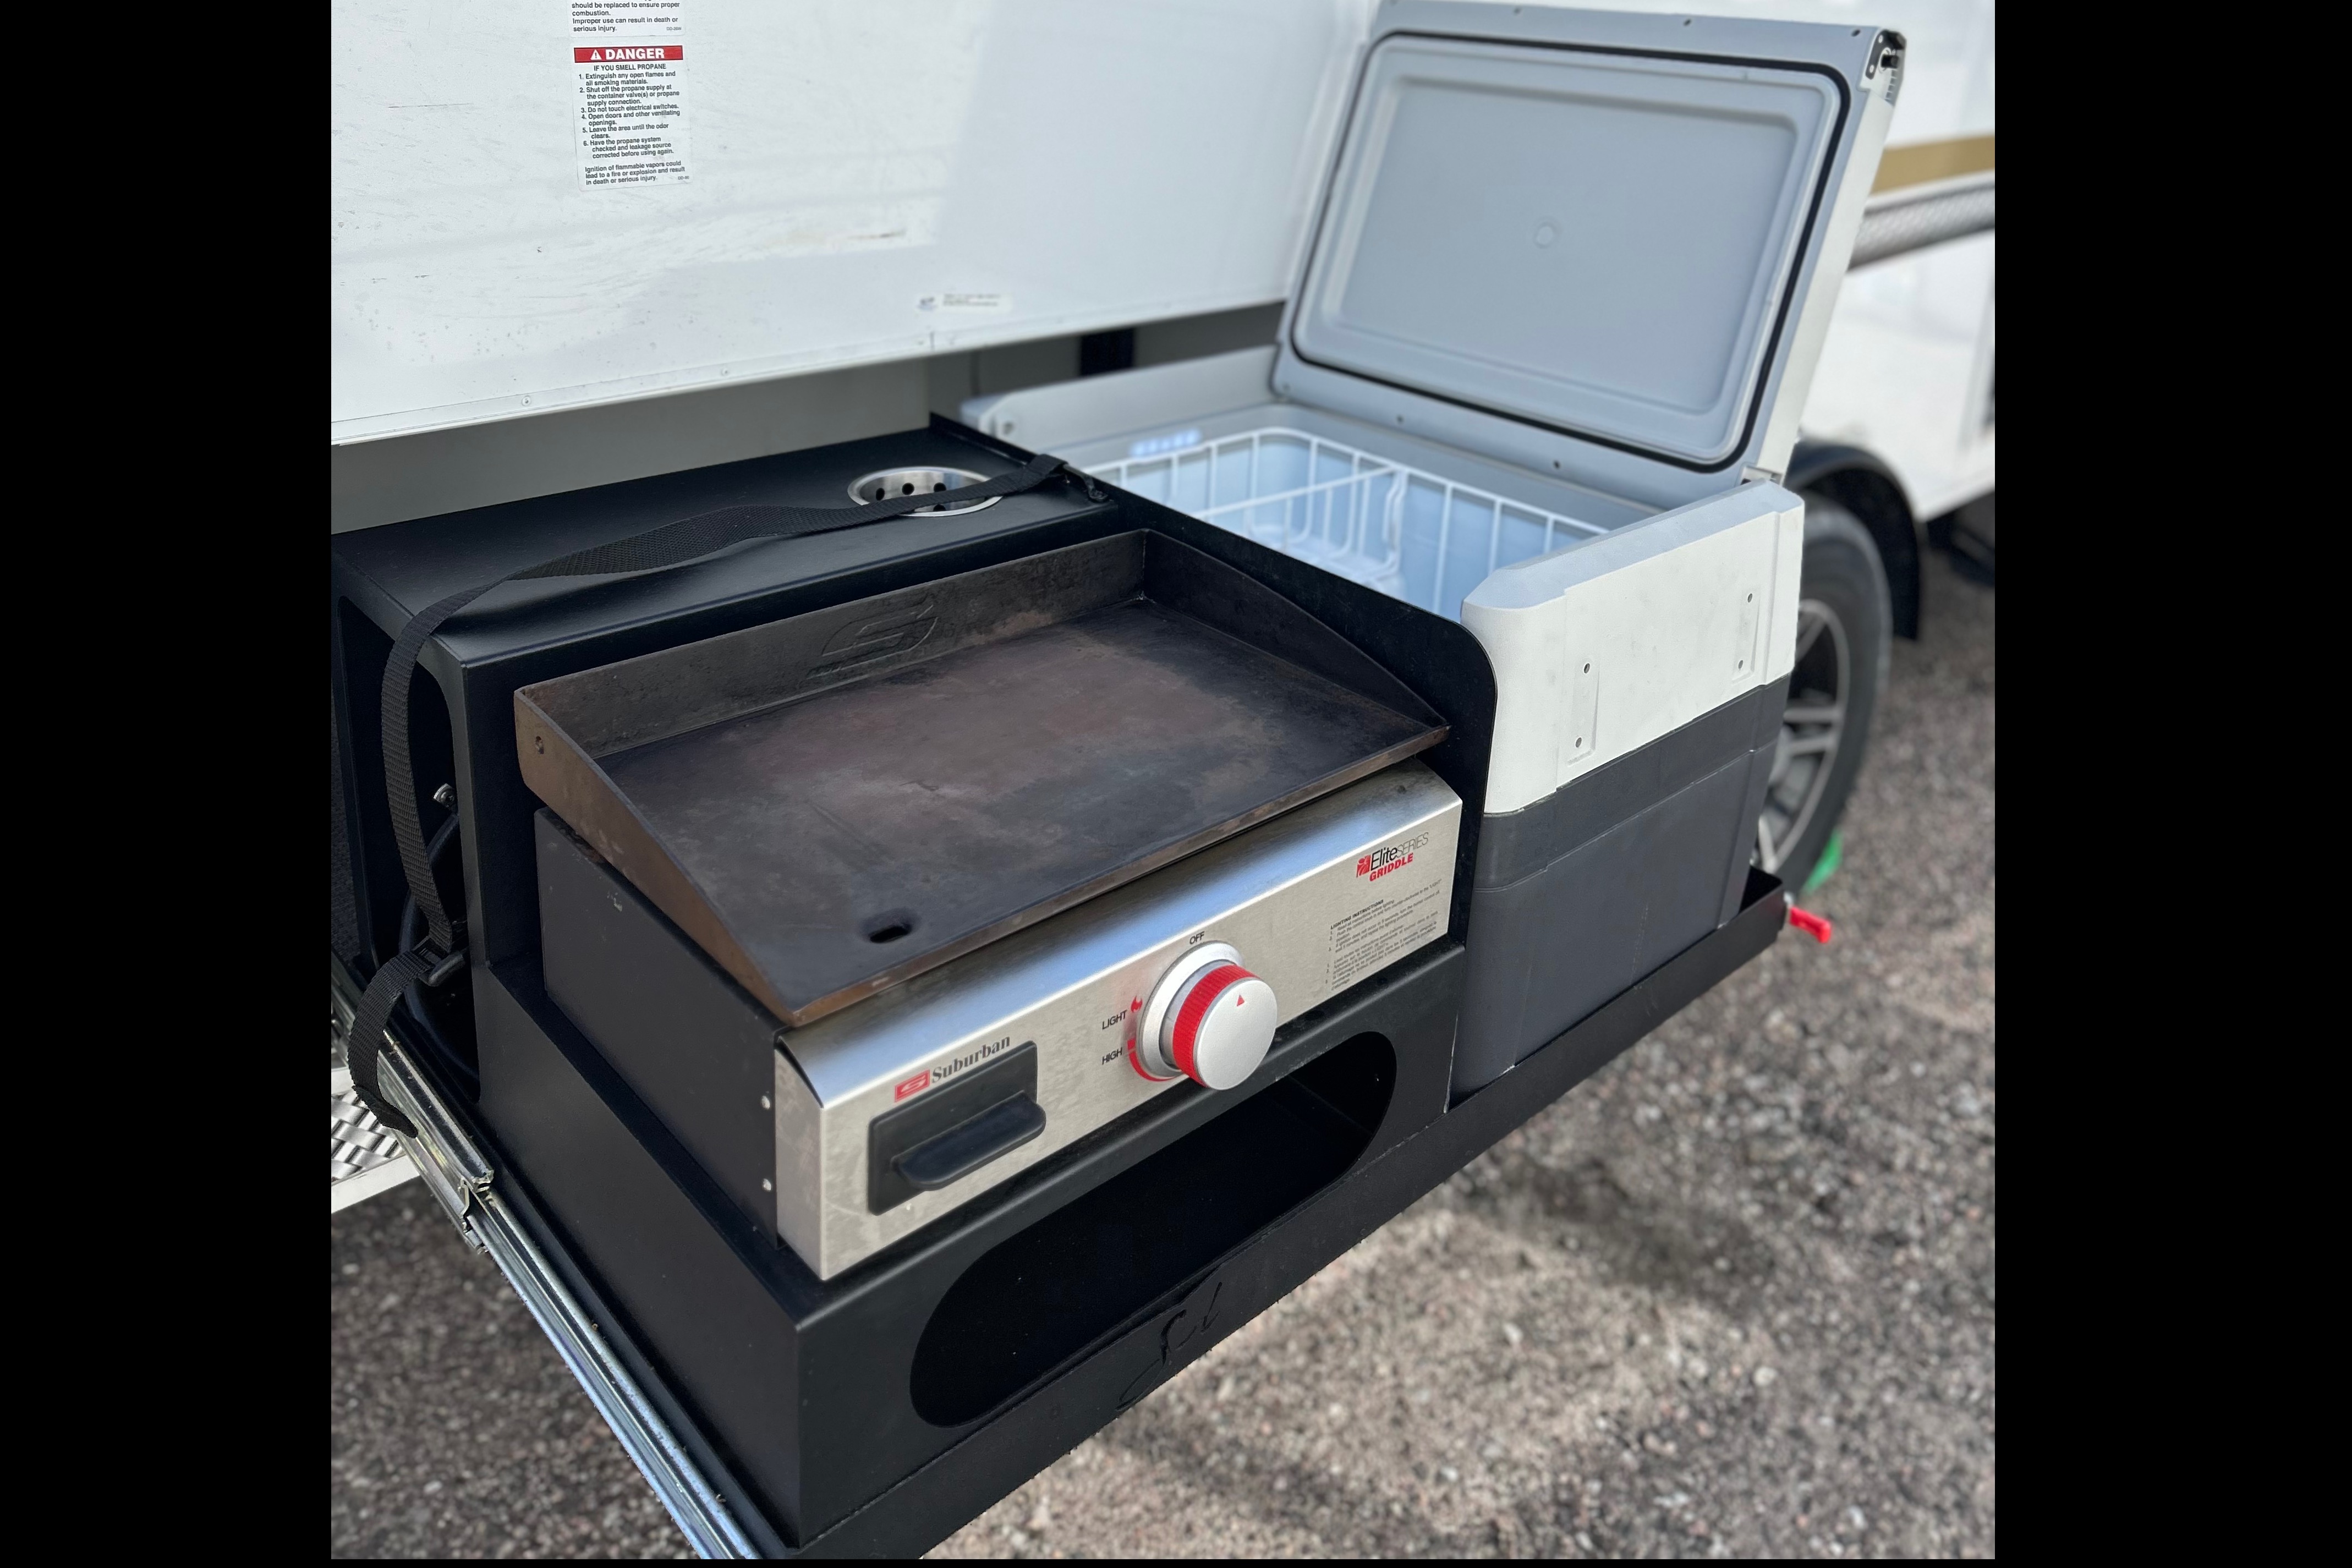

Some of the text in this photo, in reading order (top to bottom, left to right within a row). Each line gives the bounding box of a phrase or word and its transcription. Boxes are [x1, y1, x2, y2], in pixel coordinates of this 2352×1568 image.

[606, 48, 665, 59] DANGER
[1370, 852, 1413, 881] GRIDDLE
[1330, 899, 1383, 930] LIGHTING INSTRUCTIONS
[1189, 931, 1204, 945] OFF
[1102, 1010, 1127, 1030] LIGHT
[932, 1037, 1010, 1083] Suburban
[1101, 1048, 1122, 1065] HIGH
